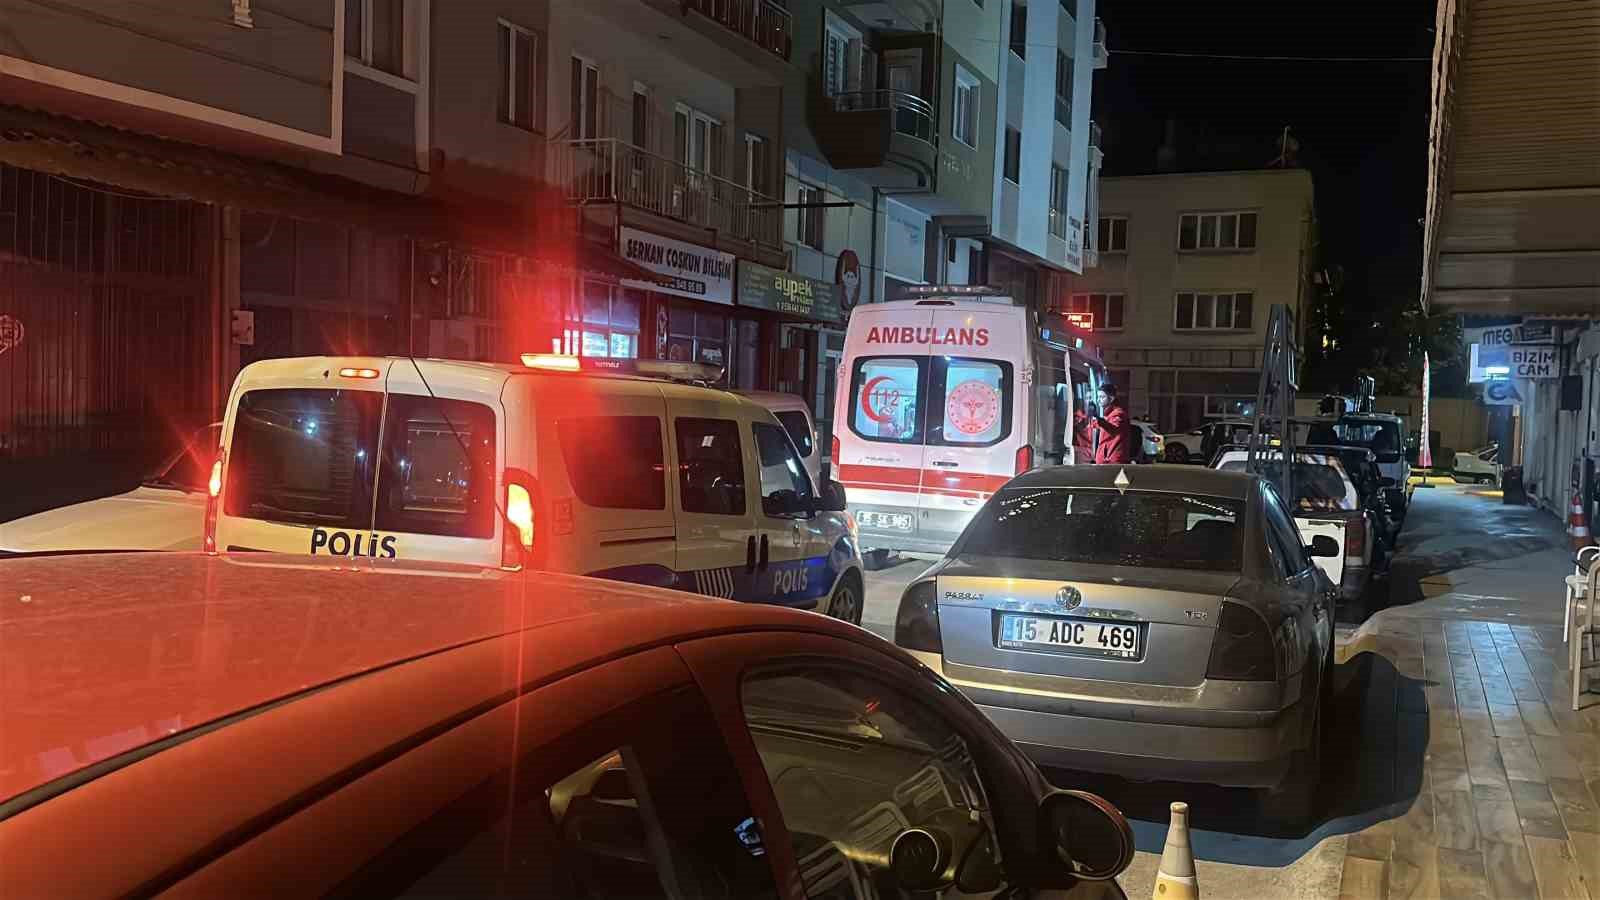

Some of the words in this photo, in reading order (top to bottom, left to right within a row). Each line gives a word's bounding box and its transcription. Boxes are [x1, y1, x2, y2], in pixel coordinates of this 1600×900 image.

[626, 239, 664, 264] SERKAN
[775, 277, 812, 302] aypek
[866, 327, 989, 346] AMBULANS
[1518, 364, 1549, 375] CAM
[875, 390, 899, 406] 112
[1016, 619, 1037, 640] 15
[1050, 621, 1084, 644] ADC
[1098, 624, 1135, 649] 469
